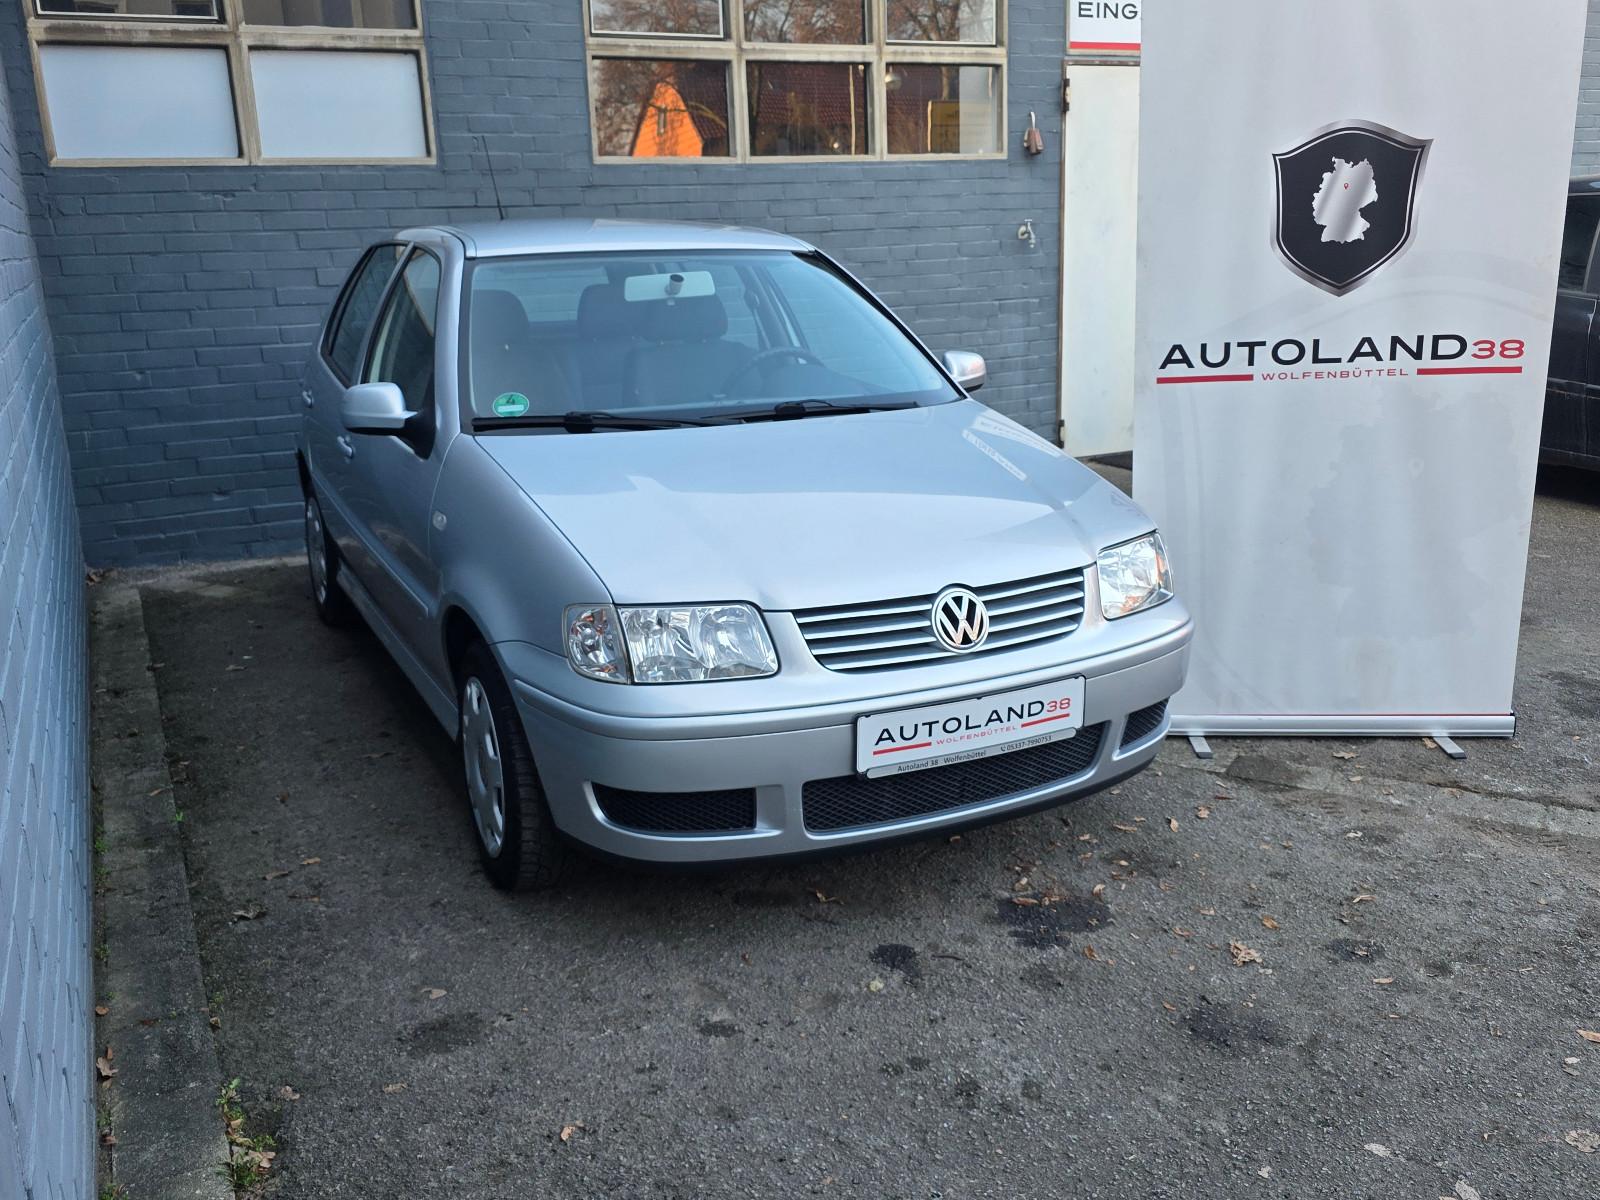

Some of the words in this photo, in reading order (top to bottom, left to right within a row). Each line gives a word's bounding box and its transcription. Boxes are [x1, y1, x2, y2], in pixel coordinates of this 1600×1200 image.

[1078, 1, 1138, 20] EING
[1158, 333, 1525, 370] AUTOLAND38
[1261, 367, 1409, 381] WOLFENBÜTTEL
[874, 697, 1071, 746] AUTOLAND38
[936, 725, 1017, 745] WOLFENBÜTTEL
[897, 760, 929, 773] Autoland
[930, 759, 939, 767] 38
[943, 750, 987, 765] Wolfenbüttel
